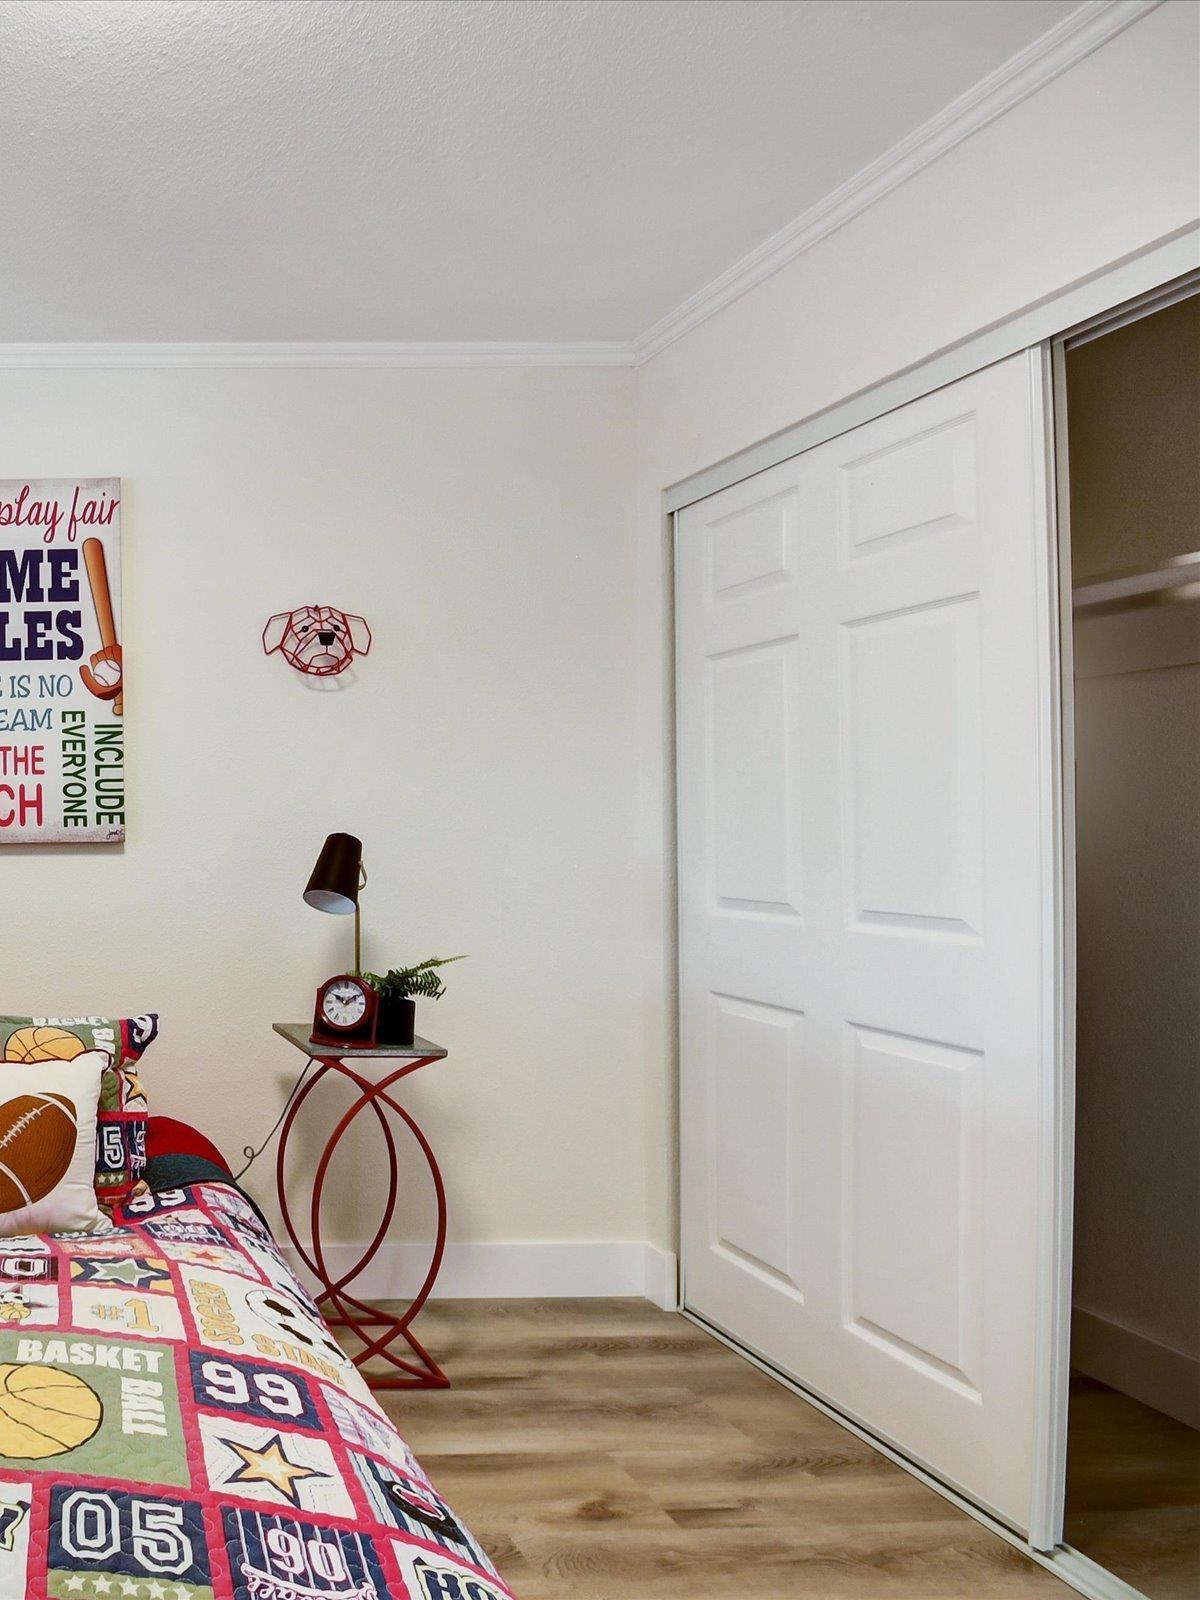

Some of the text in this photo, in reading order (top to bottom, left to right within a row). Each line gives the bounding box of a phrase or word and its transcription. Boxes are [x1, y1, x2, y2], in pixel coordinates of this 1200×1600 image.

[68, 486, 120, 542] fair
[10, 675, 31, 698] IS
[39, 675, 73, 697] NO
[62, 710, 87, 827] EVERYONE
[94, 723, 124, 825] INCLUDE
[16, 1339, 164, 1374] BASKET
[121, 1377, 168, 1436] BALL
[202, 1360, 304, 1417] 99
[62, 1491, 193, 1575] 05
[267, 1528, 346, 1582] 90
